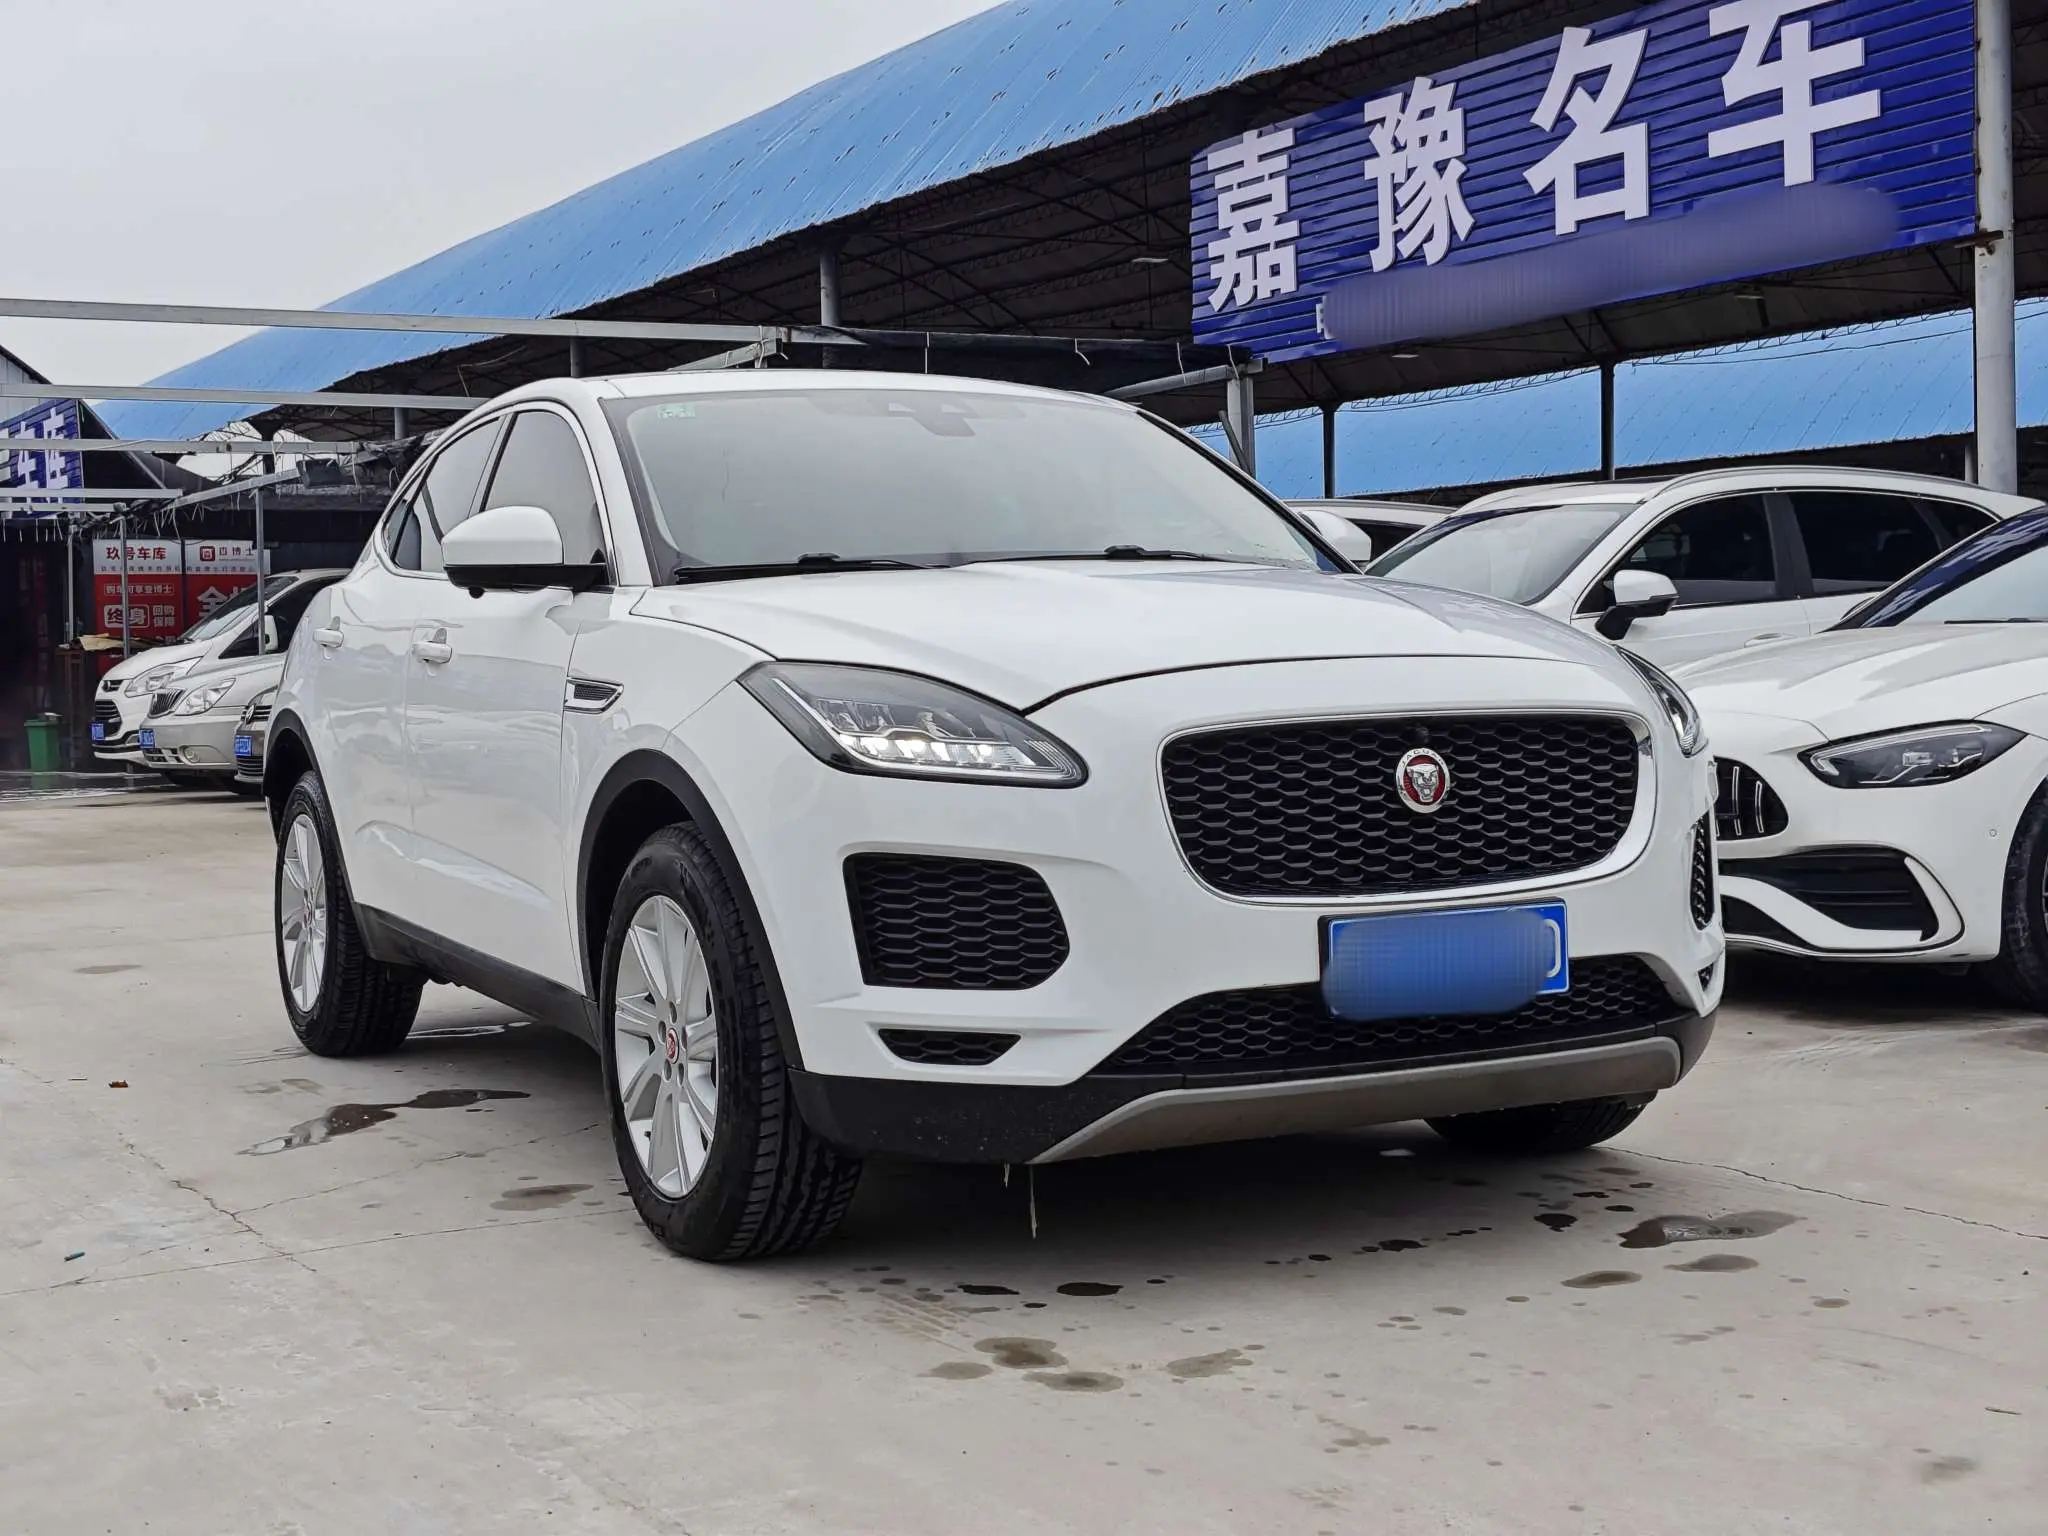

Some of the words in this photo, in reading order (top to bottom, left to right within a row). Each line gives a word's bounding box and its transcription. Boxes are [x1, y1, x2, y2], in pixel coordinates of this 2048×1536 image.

[1207, 0, 1881, 312] 嘉豫名车
[106, 546, 167, 561] 玖号车库
[106, 607, 147, 627] 终身
